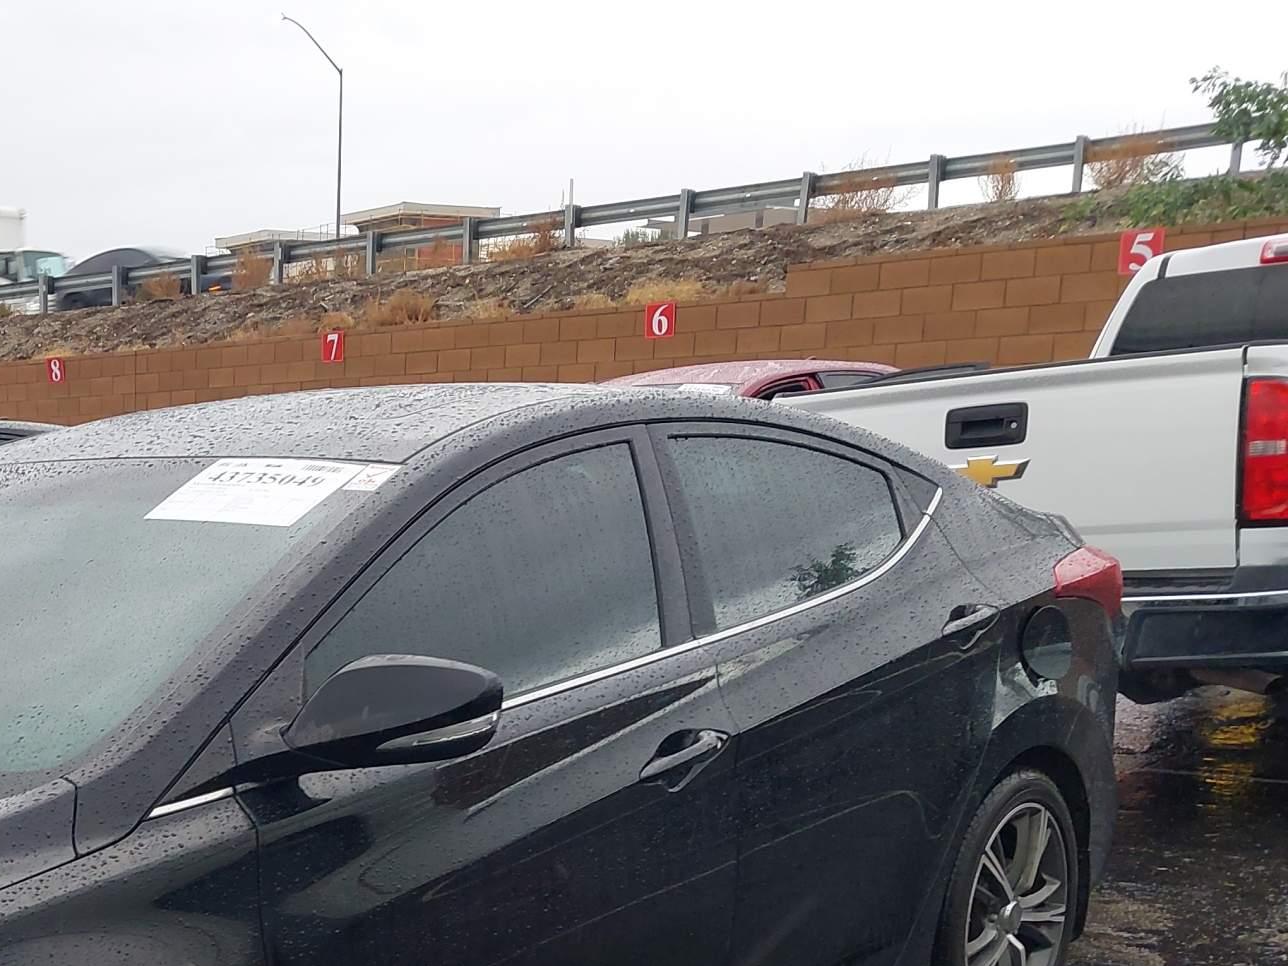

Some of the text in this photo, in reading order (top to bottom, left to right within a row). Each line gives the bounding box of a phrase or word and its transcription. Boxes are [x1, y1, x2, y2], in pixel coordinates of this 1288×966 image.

[1129, 232, 1155, 271] 5
[652, 304, 669, 336] 6
[326, 333, 339, 361] 7
[50, 359, 61, 382] 8
[208, 471, 325, 488] 43735049
